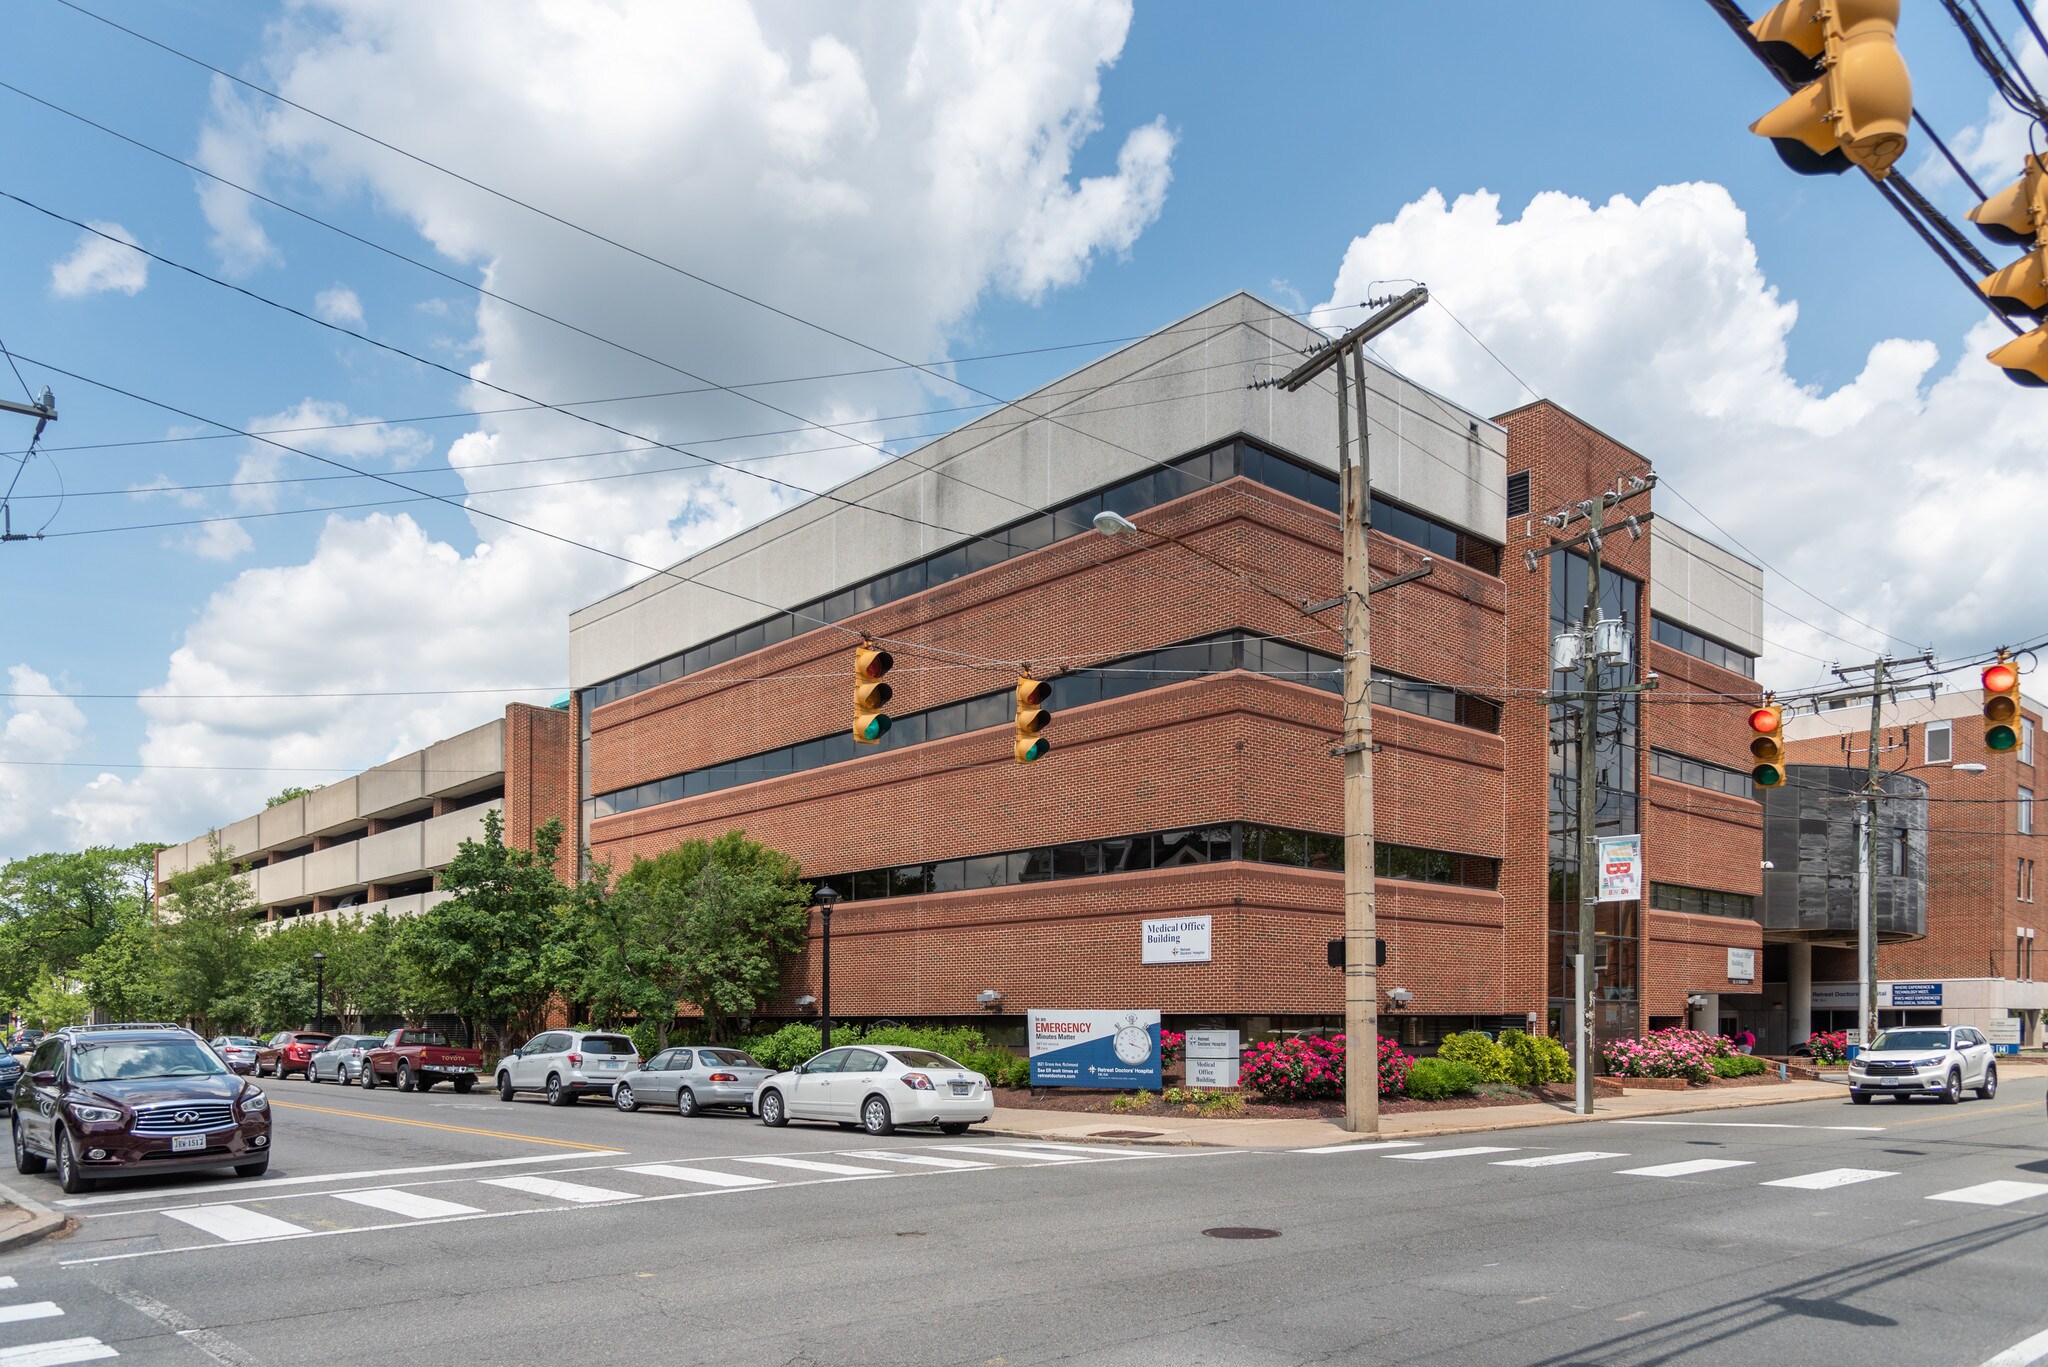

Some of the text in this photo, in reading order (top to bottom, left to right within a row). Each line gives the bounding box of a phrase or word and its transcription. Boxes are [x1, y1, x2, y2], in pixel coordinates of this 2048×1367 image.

[1606, 845, 1635, 887] VIBE
[1147, 921, 1206, 933] Medical Office
[1147, 933, 1181, 944] Building
[1035, 1022, 1092, 1033] EMERGENCY
[1195, 1076, 1216, 1084] Building
